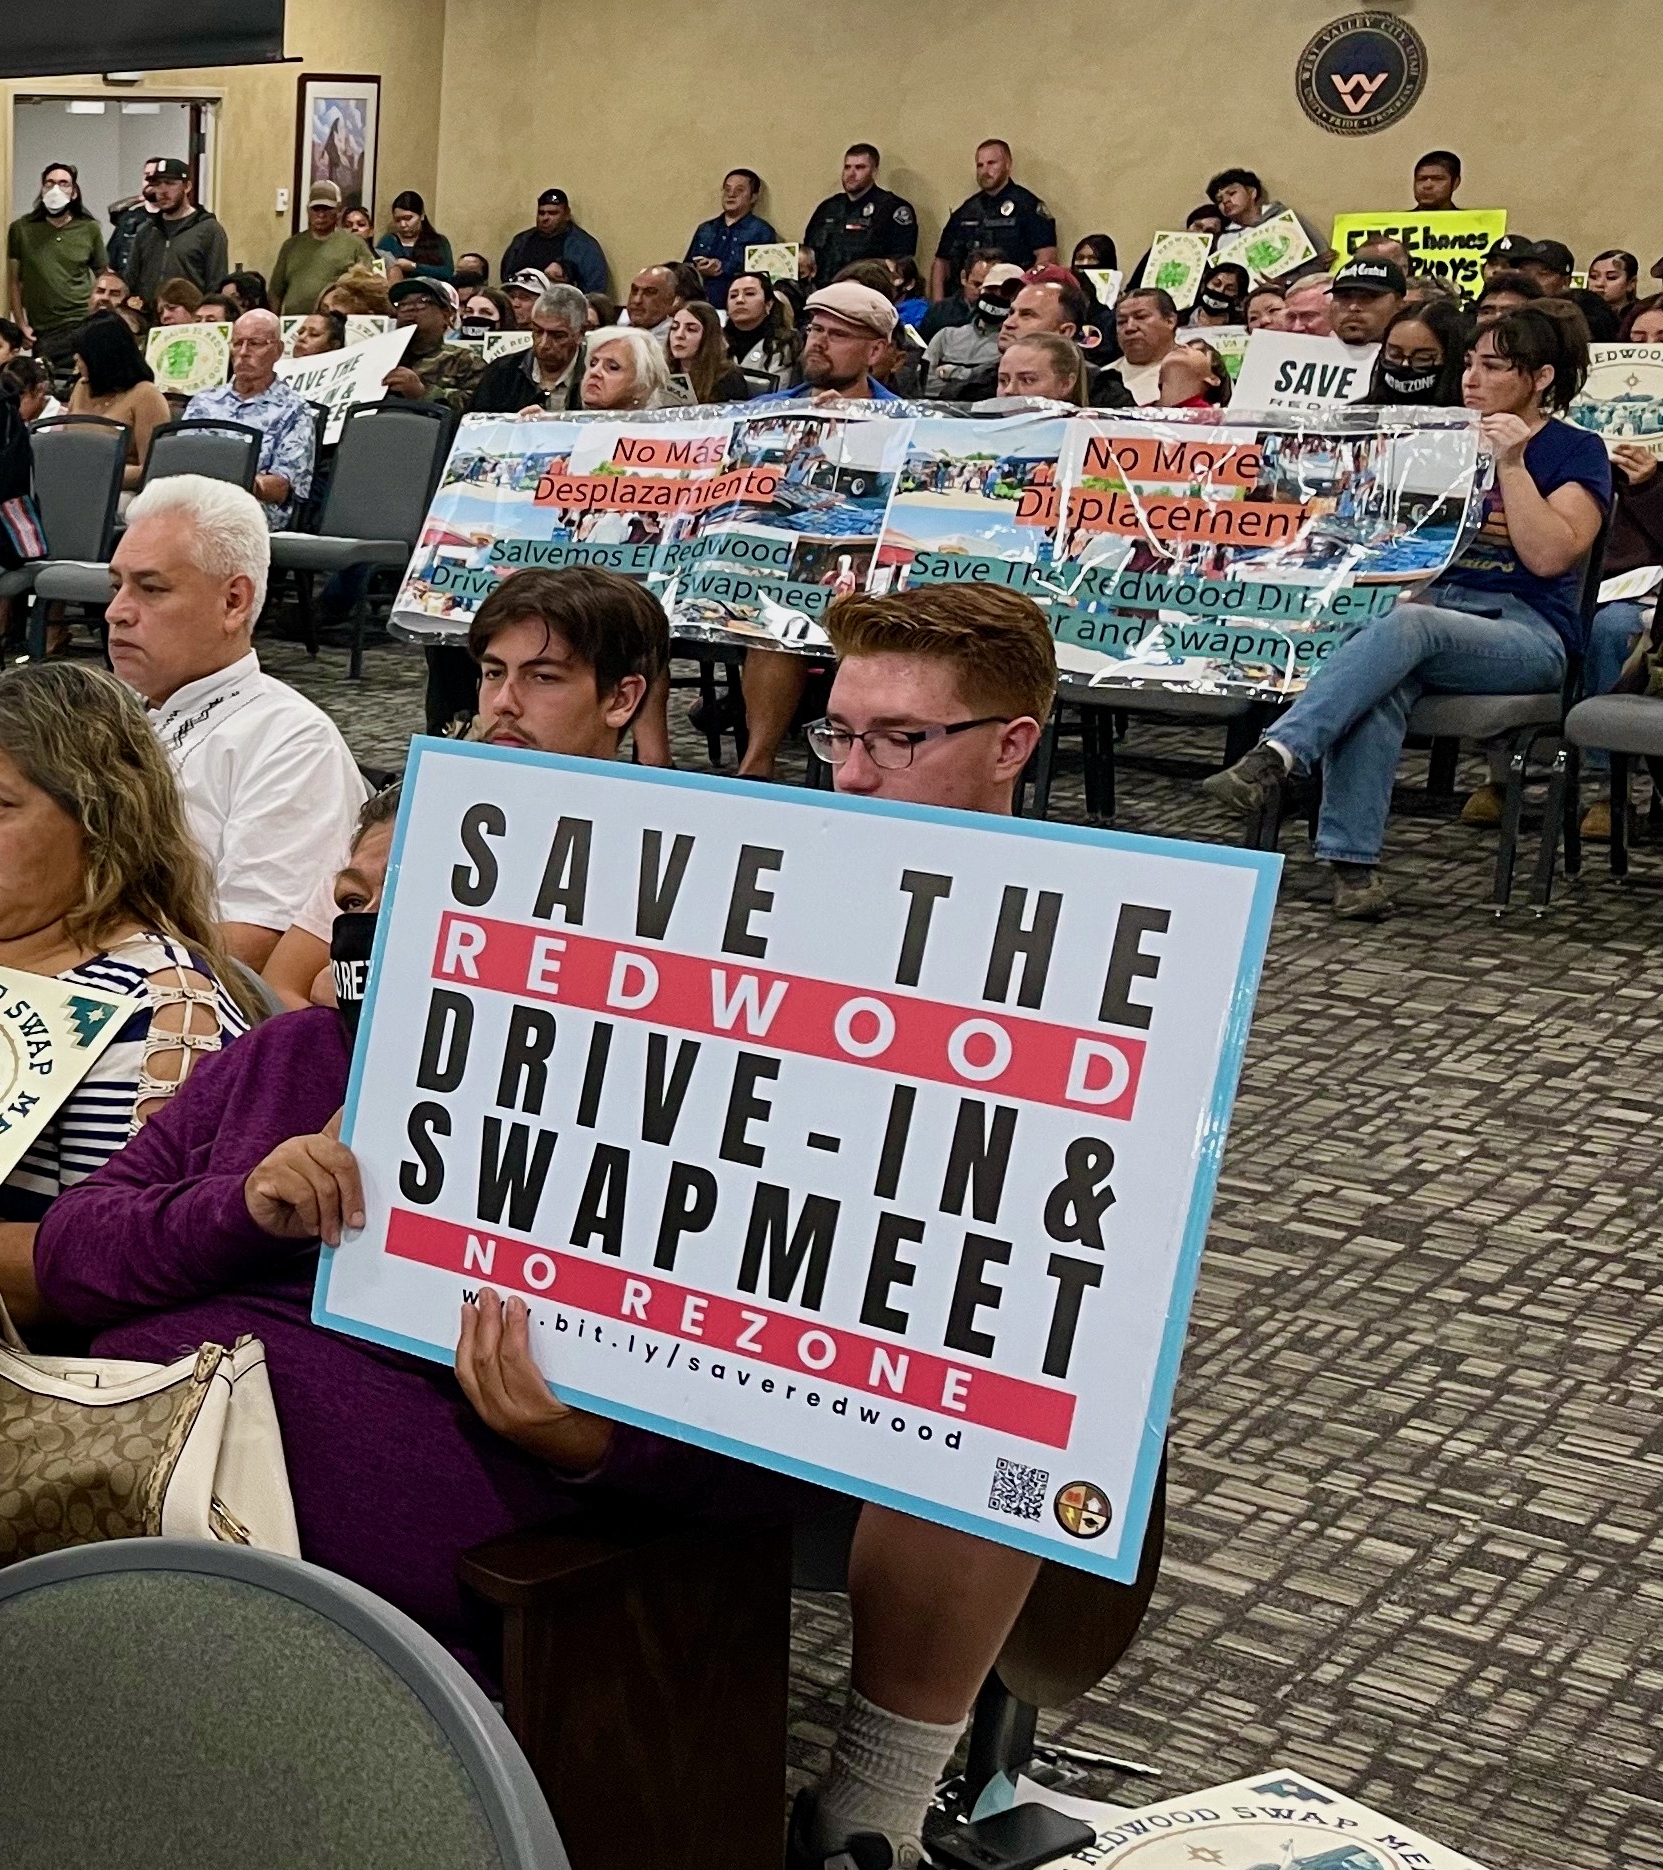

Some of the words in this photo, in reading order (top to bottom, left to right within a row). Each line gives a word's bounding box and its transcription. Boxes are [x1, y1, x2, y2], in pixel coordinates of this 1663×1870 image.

[1274, 359, 1358, 400] SAVE
[1594, 348, 1663, 364] EDWOO
[613, 438, 655, 463] No
[665, 436, 725, 463] Más
[1083, 437, 1139, 473] No
[1152, 443, 1262, 481] More
[534, 469, 778, 509] Desplazamiento
[1015, 487, 1312, 537] Displacement
[489, 539, 622, 567] Salvemos
[632, 544, 658, 567] El
[665, 535, 793, 566] Redwood
[911, 552, 993, 584] Save
[1004, 560, 1066, 589] The
[1079, 566, 1246, 610] Redwood
[1258, 585, 1397, 615] Drie-In
[1078, 613, 1145, 648] and
[1161, 622, 1339, 663] Swapmee
[449, 801, 785, 960] SAVE
[893, 866, 1174, 1032] THE
[2, 1000, 54, 1078] SWAP
[442, 919, 1131, 1108] REDWOOD
[398, 1101, 1106, 1380] SWAPMEET
[463, 1233, 557, 1292] NO
[619, 1281, 974, 1414] REZONE
[462, 1287, 964, 1451] w.bit.ly/saveredwood
[1071, 1806, 1222, 1868] REDWOOD
[1233, 1805, 1361, 1830] SWAP
